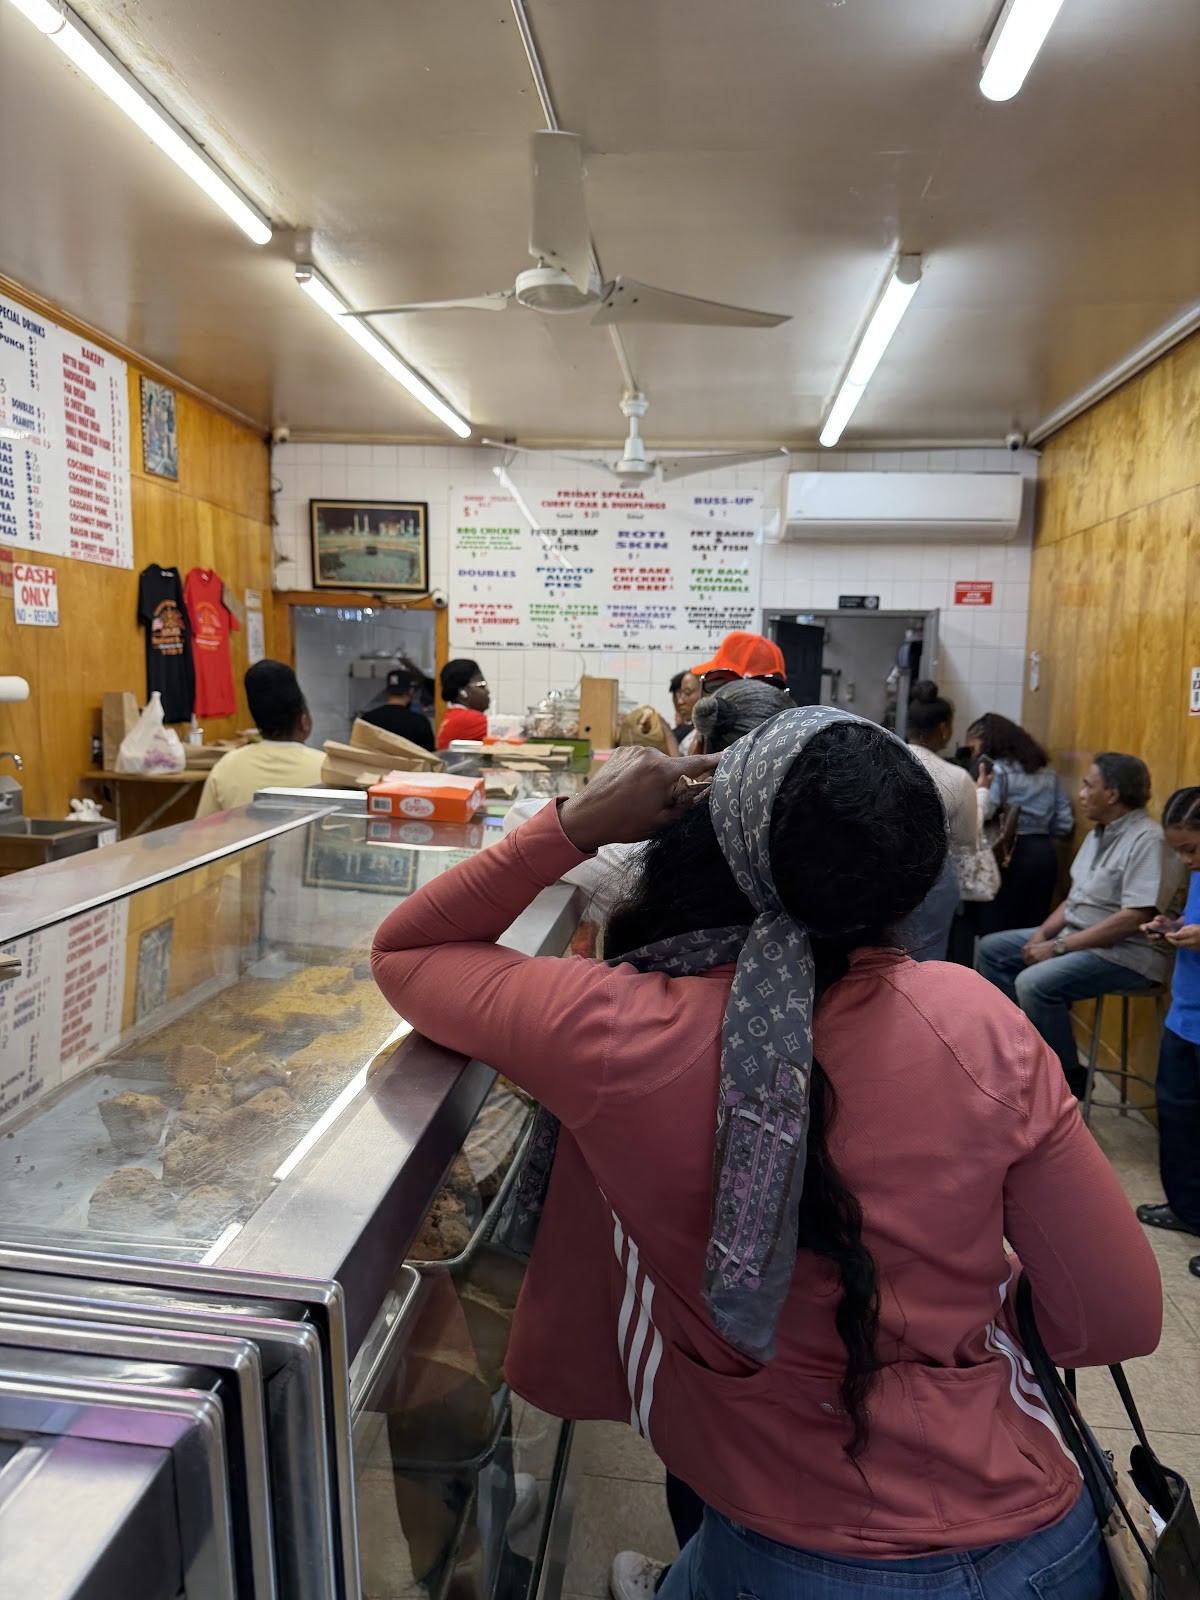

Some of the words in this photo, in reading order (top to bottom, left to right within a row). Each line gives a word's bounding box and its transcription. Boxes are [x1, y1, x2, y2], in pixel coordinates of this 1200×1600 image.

[22, 316, 45, 338] DRINKS
[694, 497, 754, 505] BUSS-UP
[612, 502, 666, 510] DUMPLINGS
[480, 528, 520, 536] CHICKEN
[562, 529, 599, 537] SHRIMP
[14, 566, 56, 585] CASH
[458, 569, 517, 578] DOUBLES
[22, 585, 50, 608] ONLY
[16, 608, 26, 621] NO
[482, 617, 520, 626] SHRIMPS
